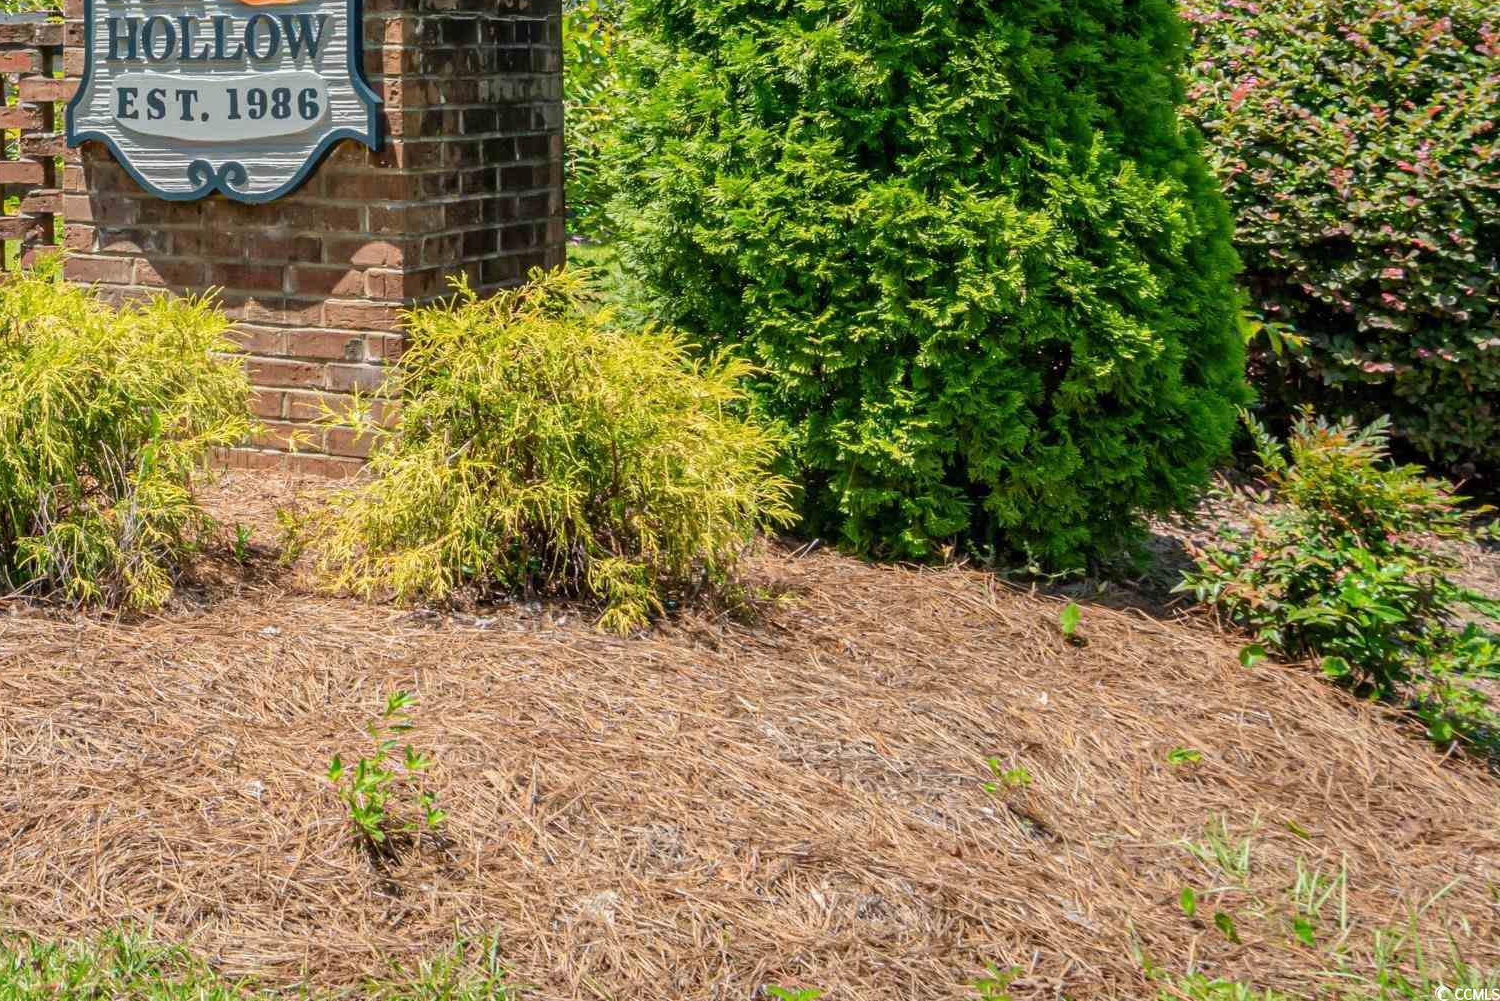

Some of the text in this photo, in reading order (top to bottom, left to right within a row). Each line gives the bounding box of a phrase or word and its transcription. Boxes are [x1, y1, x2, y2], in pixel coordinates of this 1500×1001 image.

[106, 13, 329, 62] HOLLOW
[116, 87, 320, 122] EST. 1986
